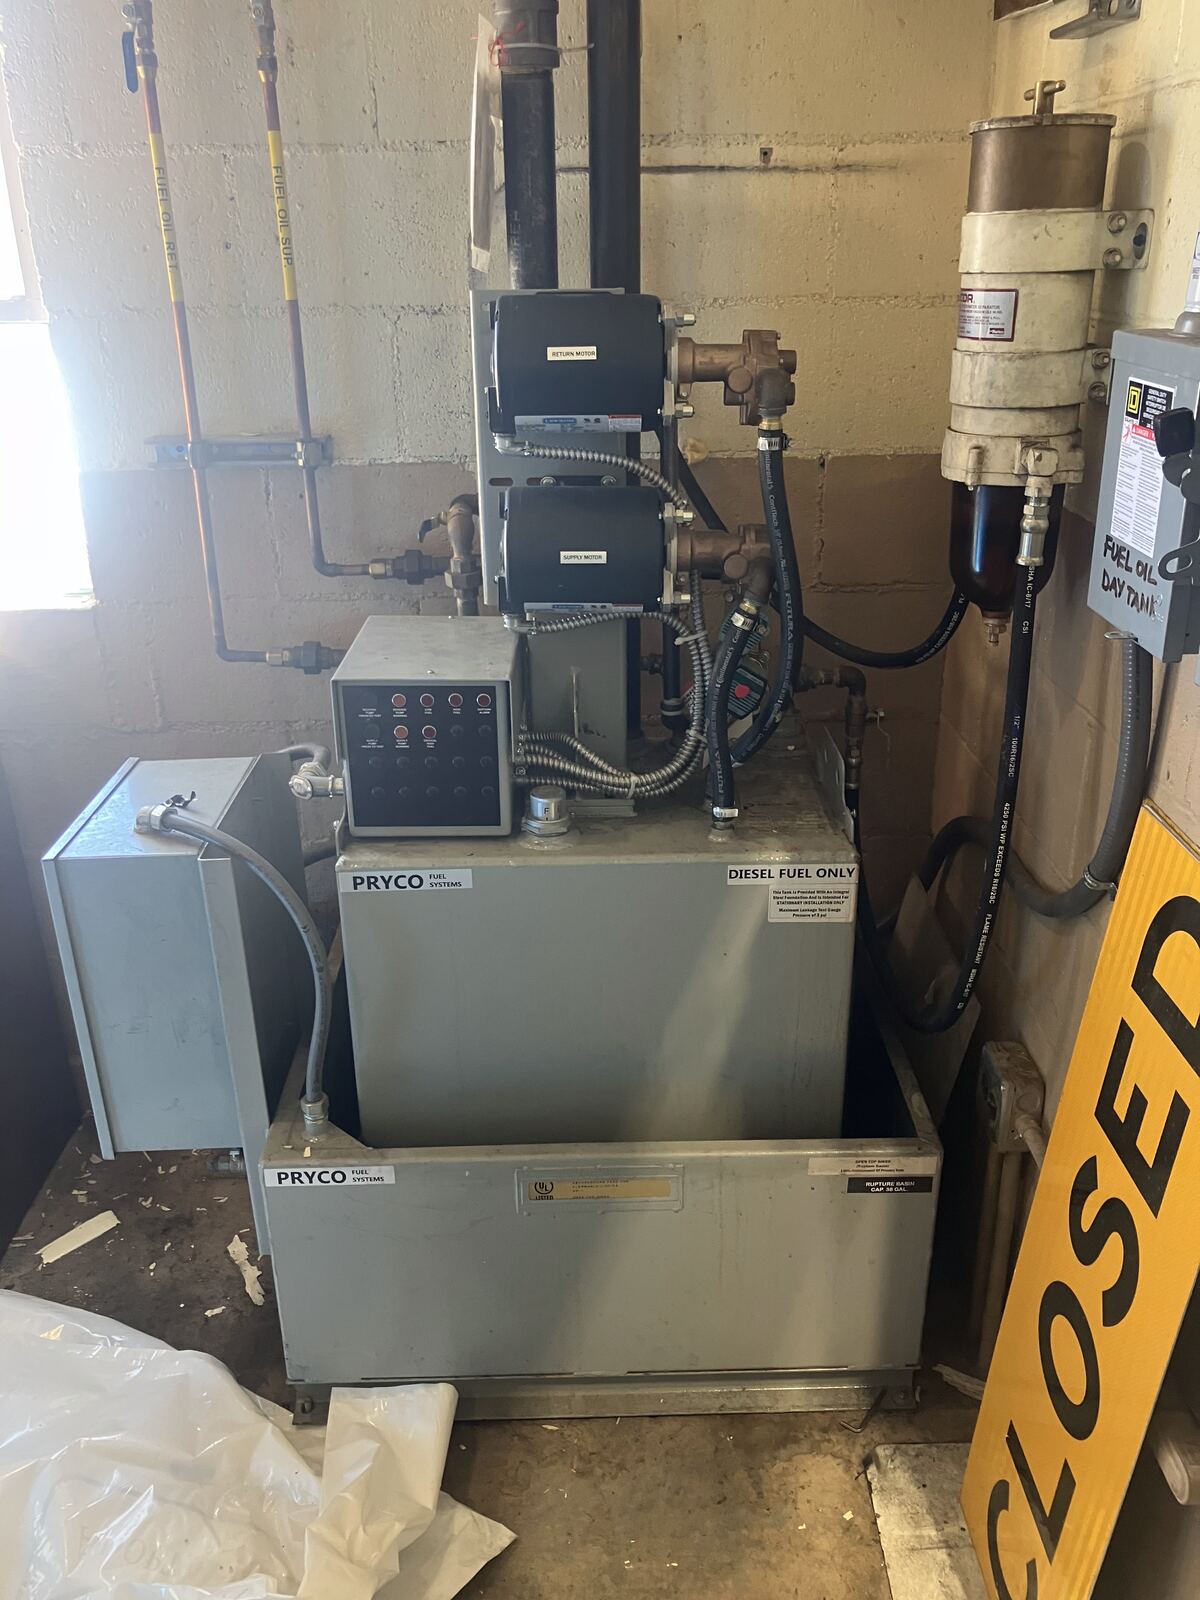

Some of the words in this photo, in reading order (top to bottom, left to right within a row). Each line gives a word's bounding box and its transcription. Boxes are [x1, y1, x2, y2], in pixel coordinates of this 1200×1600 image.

[154, 166, 171, 202] FUEL
[272, 165, 286, 205] FUEL
[277, 208, 289, 233] OIL
[1103, 534, 1133, 573] FUEL
[1136, 559, 1158, 586] OIL
[1102, 567, 1125, 598] DAY
[785, 592, 794, 641] FUTURA
[1022, 620, 1030, 635] CSI
[1002, 802, 1011, 819] 4250
[999, 832, 1007, 845] WP
[1000, 820, 1008, 832] PSI
[729, 869, 774, 879] DIESEL
[779, 868, 812, 878] FUEL
[816, 867, 855, 878] ONLY
[993, 845, 1005, 877] EXCEEDS
[352, 874, 424, 890] PRYCO
[981, 914, 992, 934] FLAME
[974, 934, 988, 965] RESISTANT
[277, 1170, 347, 1184] PRYCO
[988, 895, 1200, 1600] CLOSED
